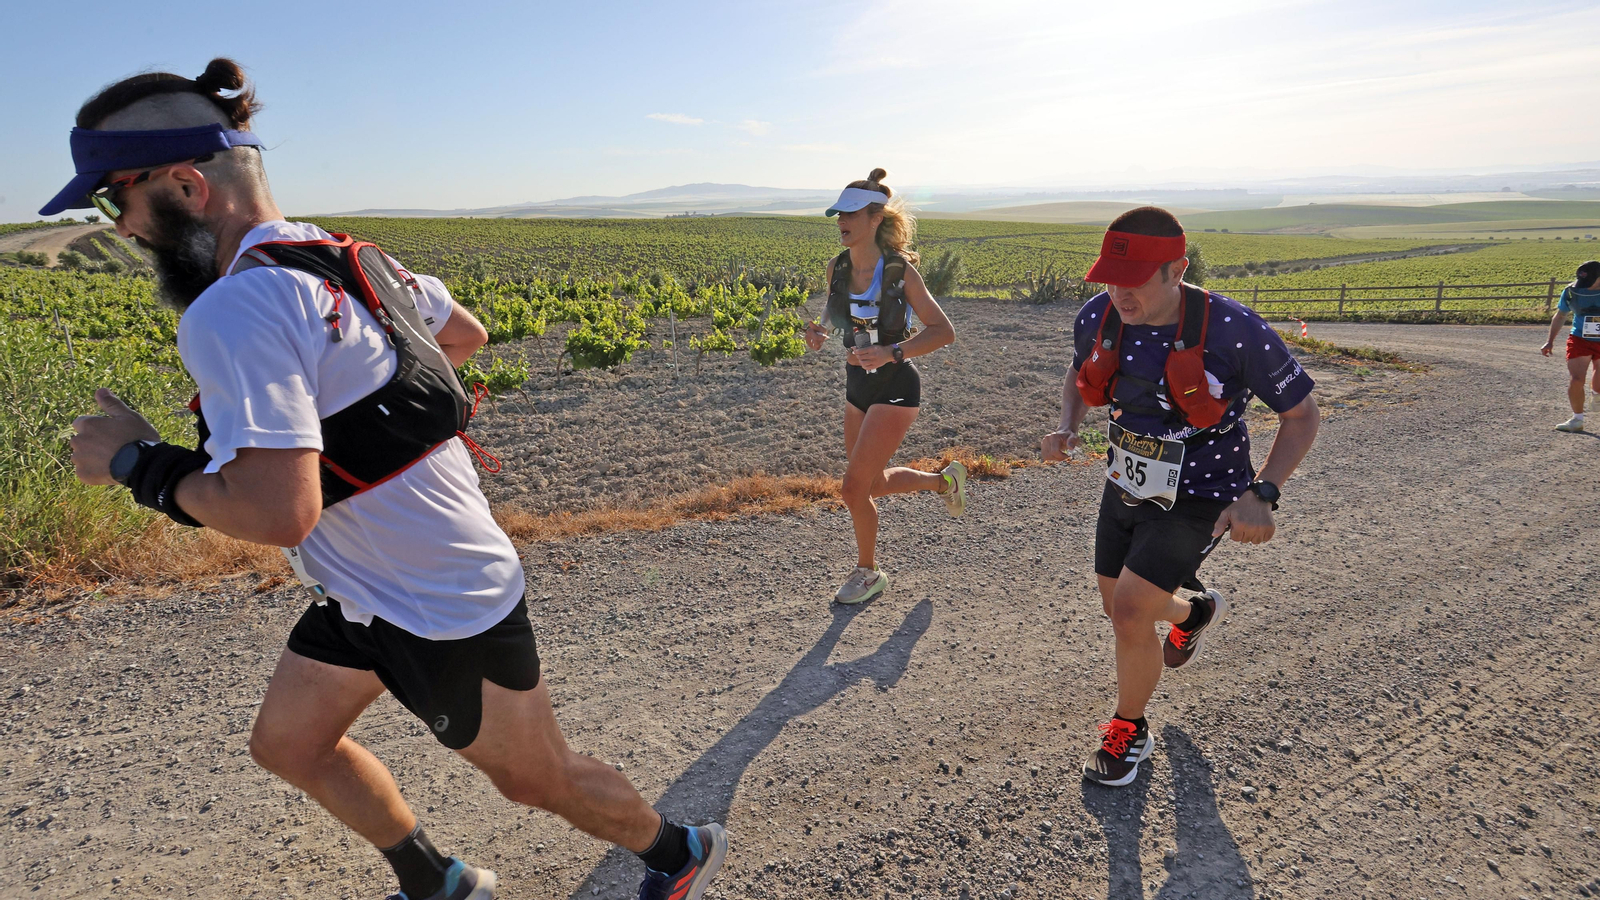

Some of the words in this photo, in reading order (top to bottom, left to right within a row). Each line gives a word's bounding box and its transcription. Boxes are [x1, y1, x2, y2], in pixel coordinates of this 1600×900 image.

[1275, 373, 1296, 395] Jerez
[1125, 432, 1158, 455] Sherry
[1125, 456, 1148, 487] 85
